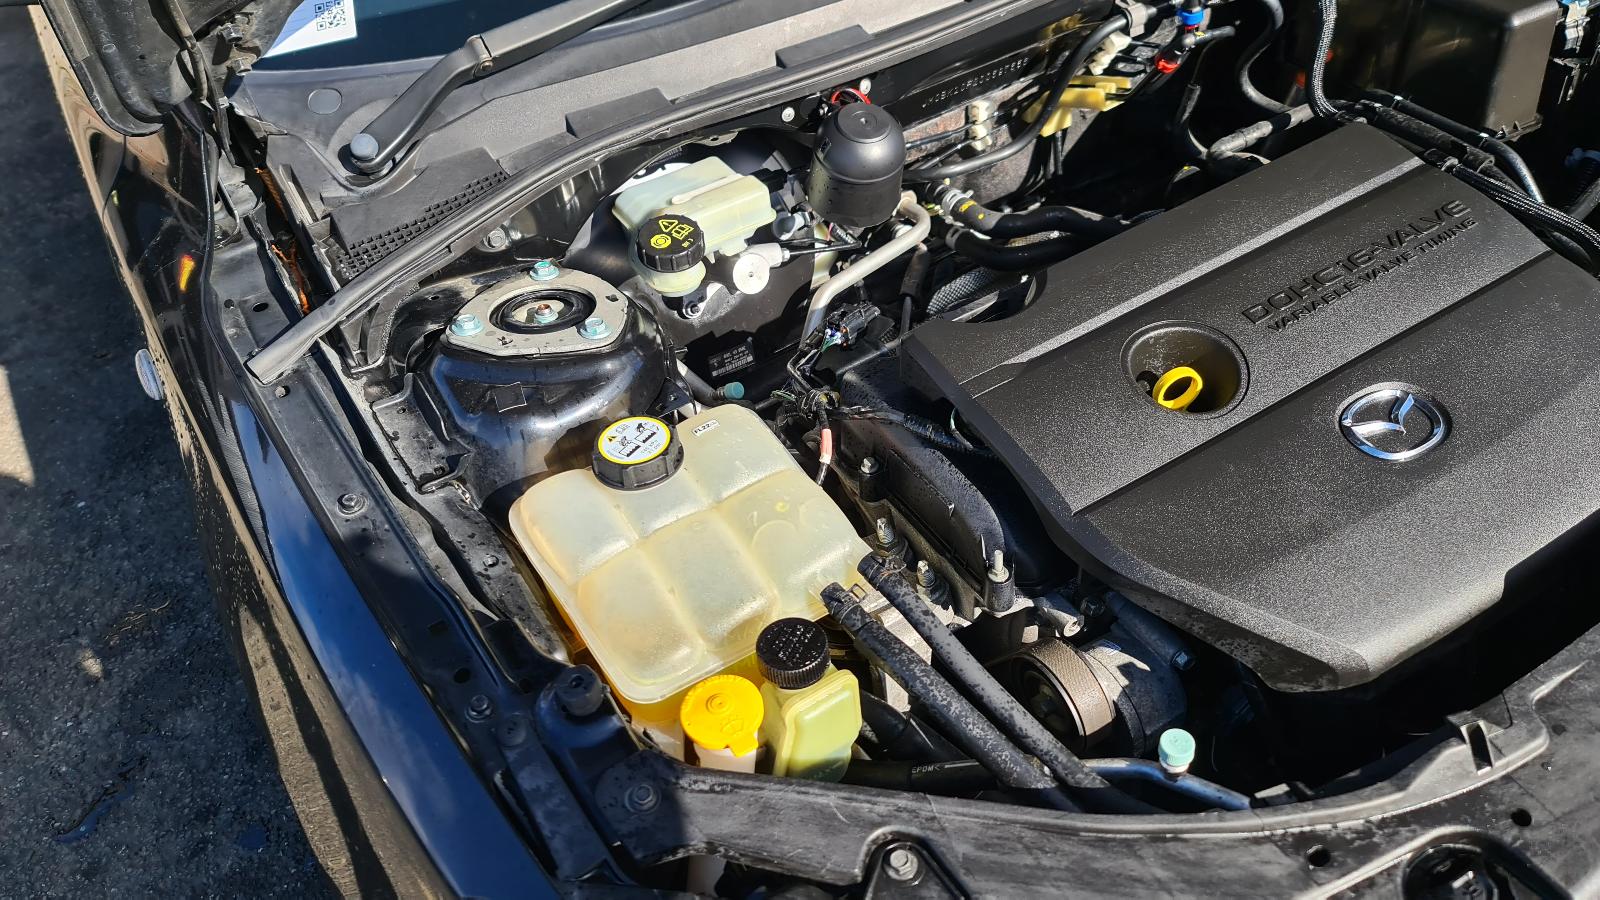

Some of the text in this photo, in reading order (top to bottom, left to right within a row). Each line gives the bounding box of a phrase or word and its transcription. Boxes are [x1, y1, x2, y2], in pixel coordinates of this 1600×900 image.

[1241, 266, 1345, 325] DOHC
[1267, 216, 1479, 333] VARIABLE VALVE TIMING
